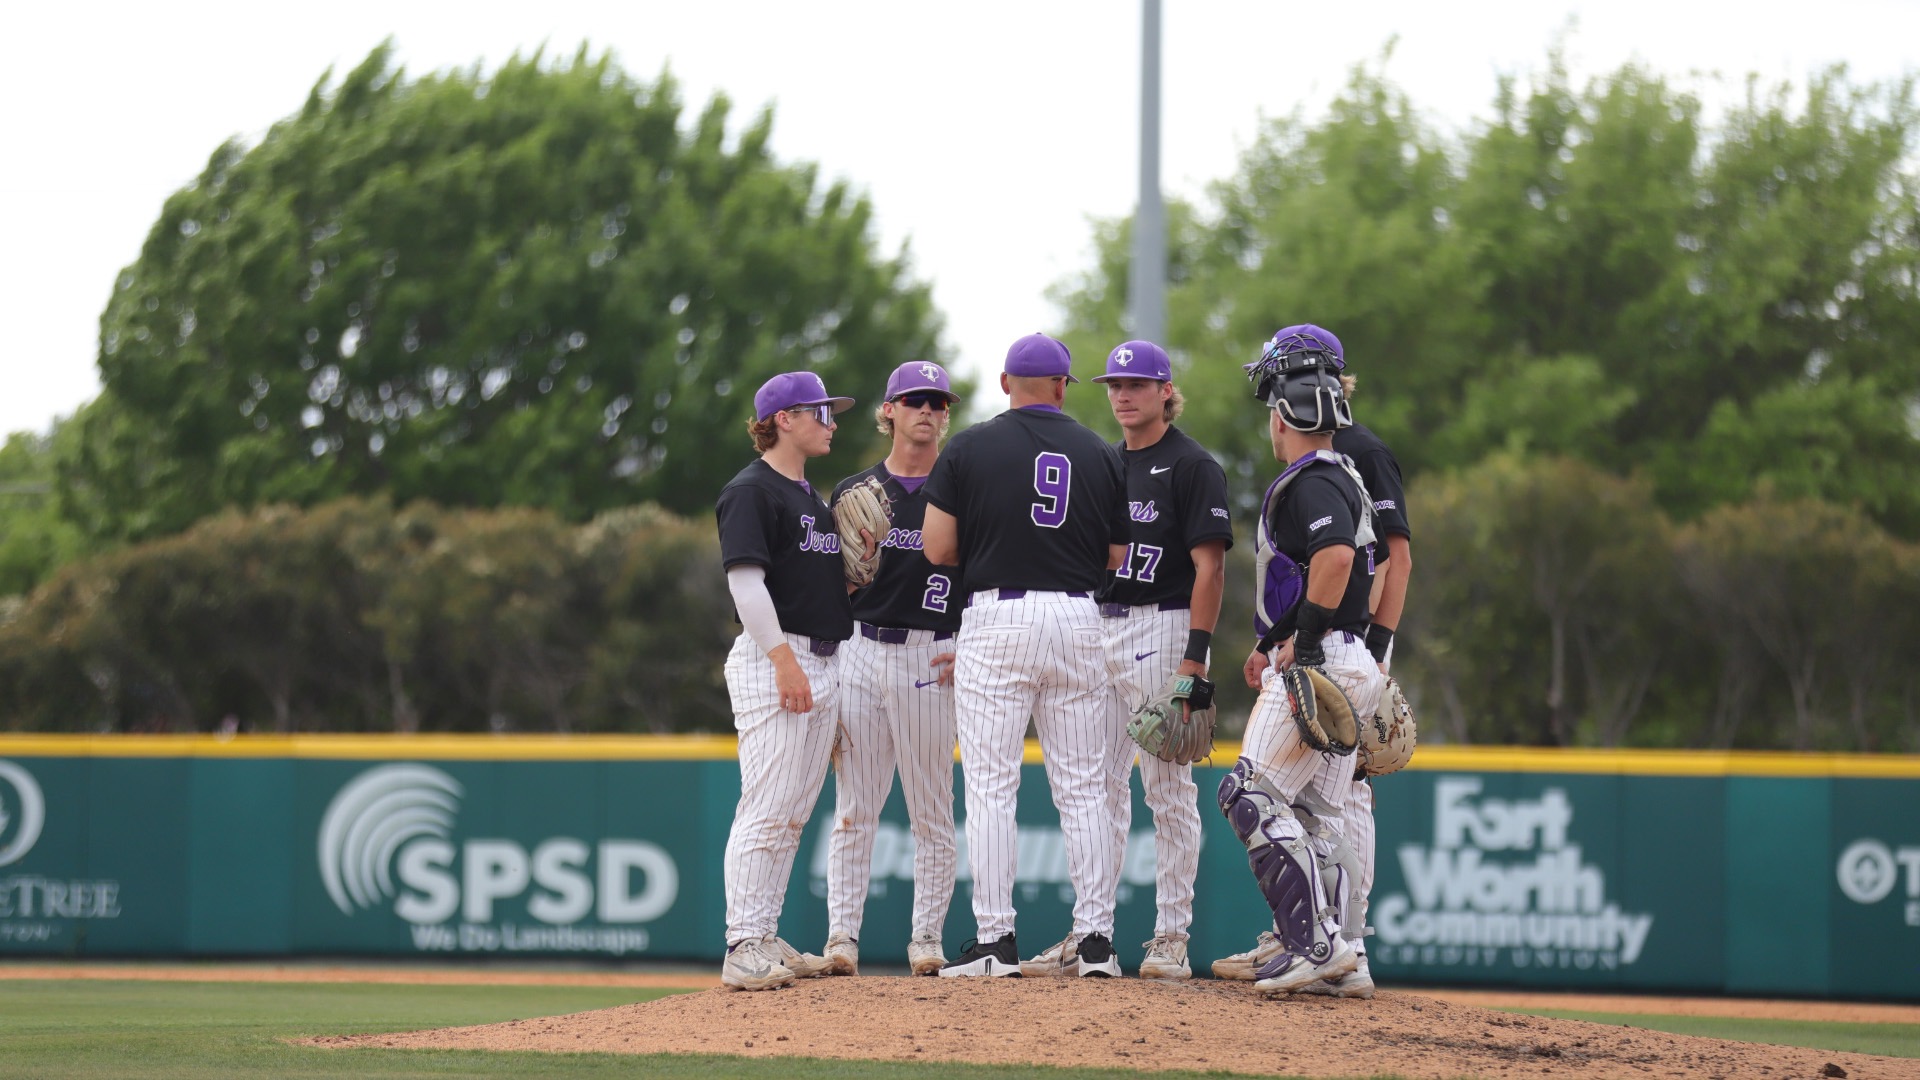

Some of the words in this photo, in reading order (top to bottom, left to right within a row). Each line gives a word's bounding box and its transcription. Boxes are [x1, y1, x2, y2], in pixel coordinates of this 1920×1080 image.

[1031, 451, 1071, 528] 9
[1373, 500, 1395, 510] WAC
[1309, 516, 1332, 531] WAC
[922, 573, 951, 613] 2
[1433, 776, 1570, 850] Fort
[393, 837, 678, 924] SPSD
[1397, 843, 1604, 912] Worth
[502, 923, 649, 955] Landscape
[1374, 894, 1653, 964] Community
[1511, 948, 1621, 969] UNION
